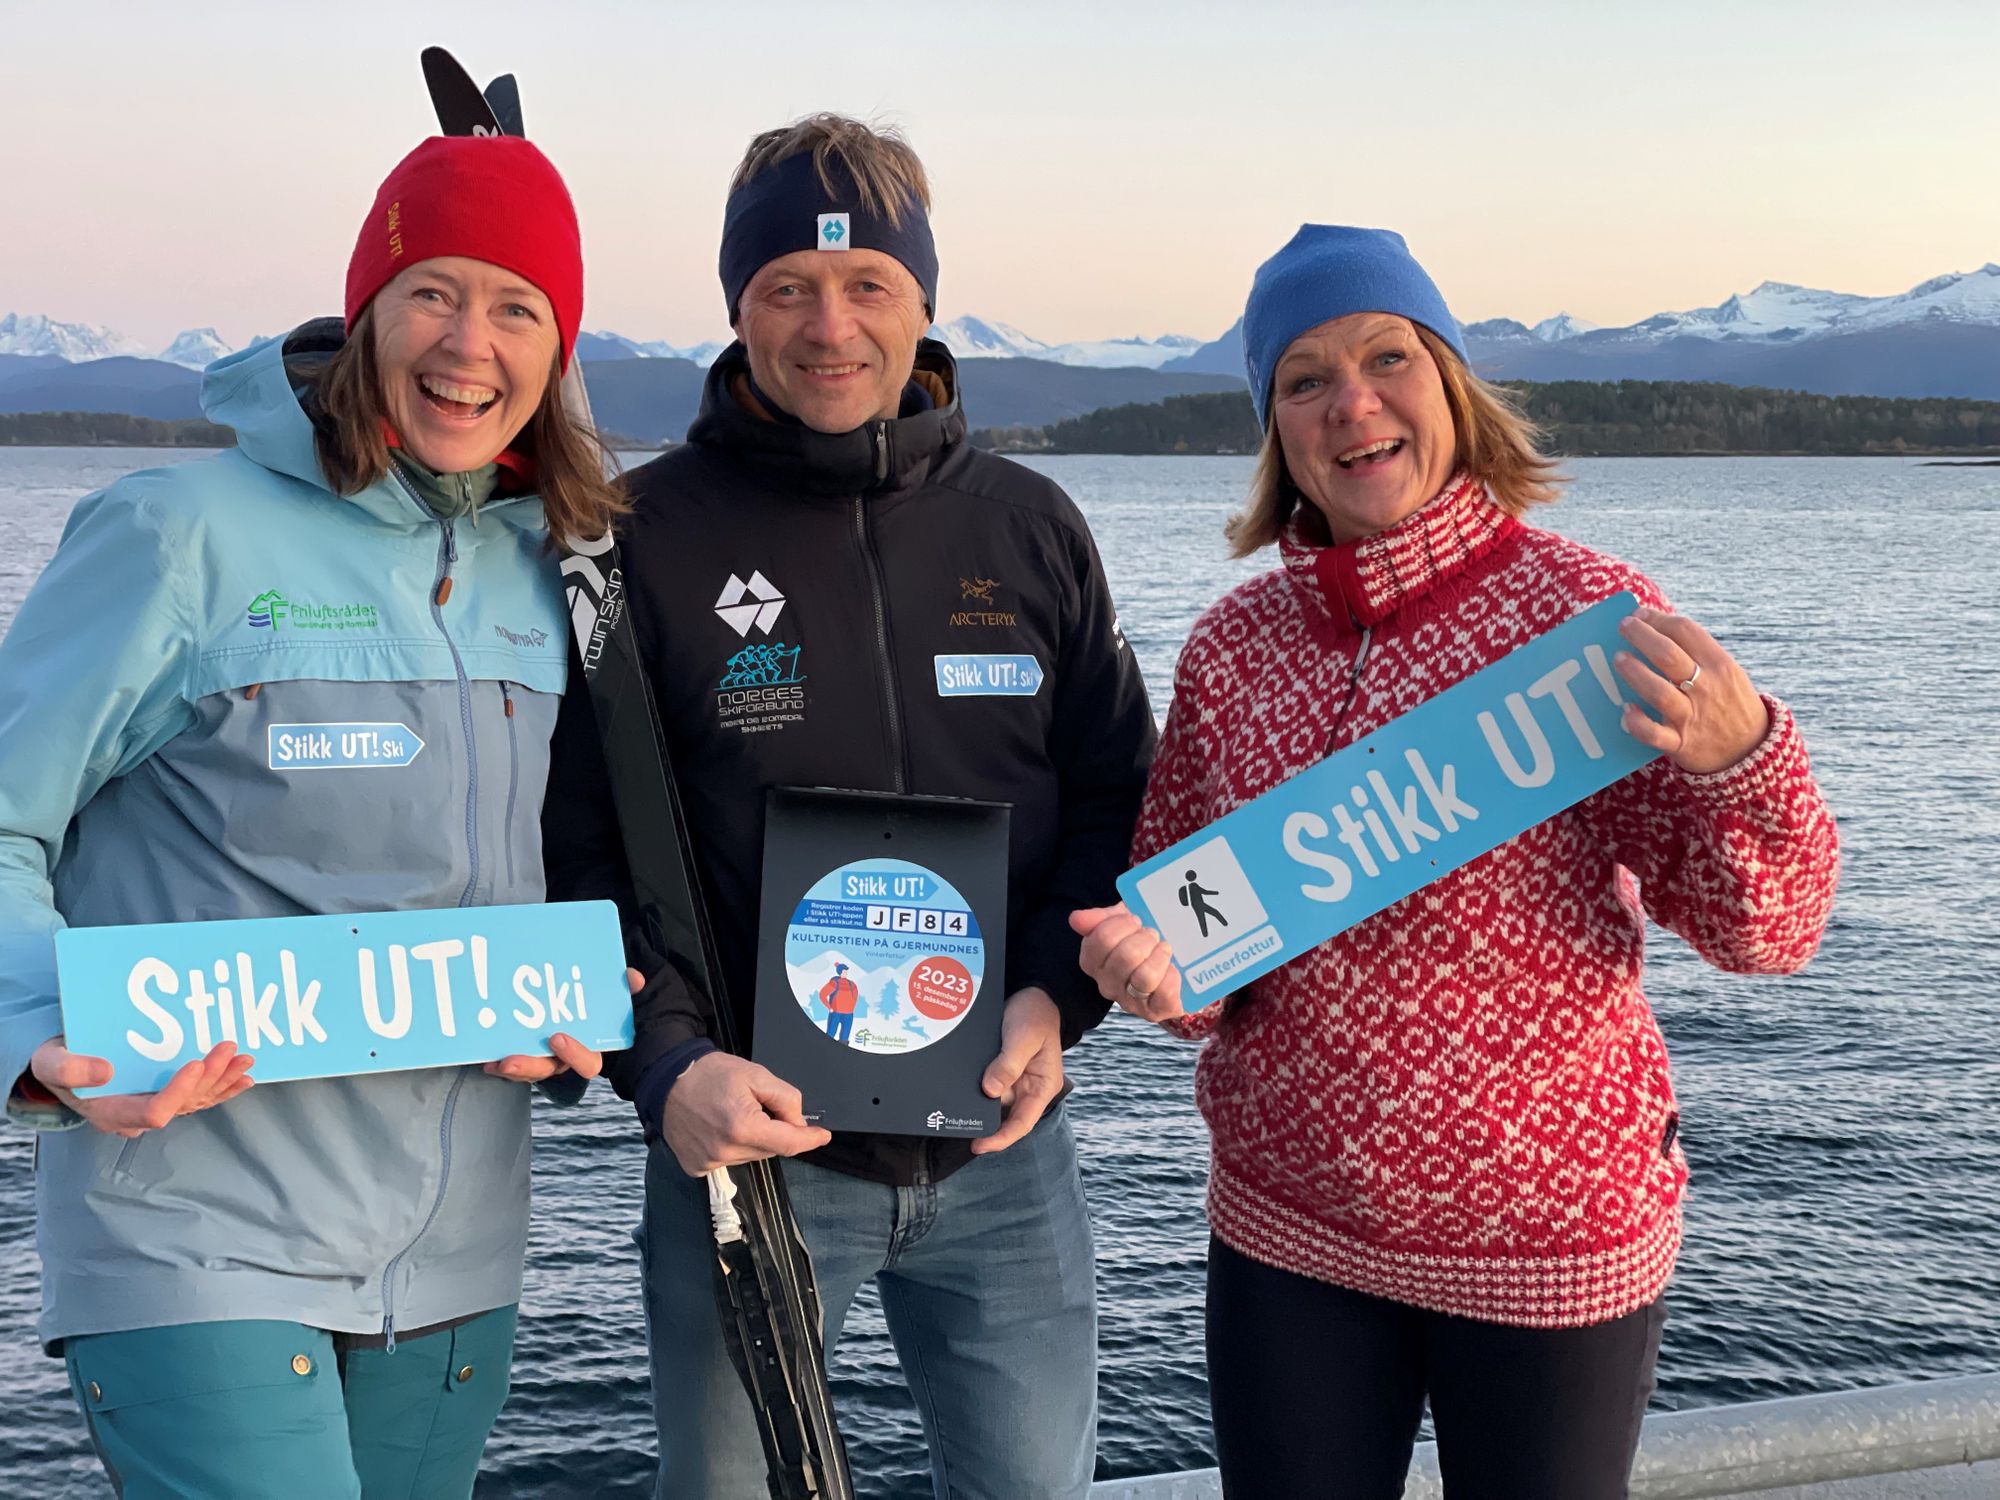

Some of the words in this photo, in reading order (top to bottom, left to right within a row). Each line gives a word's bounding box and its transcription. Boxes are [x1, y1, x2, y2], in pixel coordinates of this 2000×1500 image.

[291, 603, 377, 620] Friluftsrådet
[583, 618, 610, 671] TWIN
[600, 568, 622, 618] SKIN
[610, 599, 624, 630] POWER
[943, 664, 983, 688] Stikk
[988, 663, 1018, 687] UT!
[1020, 671, 1034, 687] Ski
[717, 686, 804, 707] NORGES
[718, 700, 804, 717] SKIFORBUND
[277, 733, 333, 761] Stikk
[341, 732, 380, 759] UT!
[382, 740, 404, 758] Ski
[1282, 748, 1480, 903] Stikk
[1476, 644, 1631, 788] UT!
[846, 876, 887, 897] Stikk
[894, 877, 925, 898] UT!
[792, 932, 870, 947] KULTURSTIEN
[874, 937, 889, 948] PÅ
[892, 940, 980, 955] GJERMUNDNES
[1192, 935, 1276, 988] Vinterfottur
[917, 965, 969, 994] 2023
[126, 949, 328, 1062] Stikk
[358, 934, 497, 1040] UT!
[512, 962, 588, 1029] Ski
